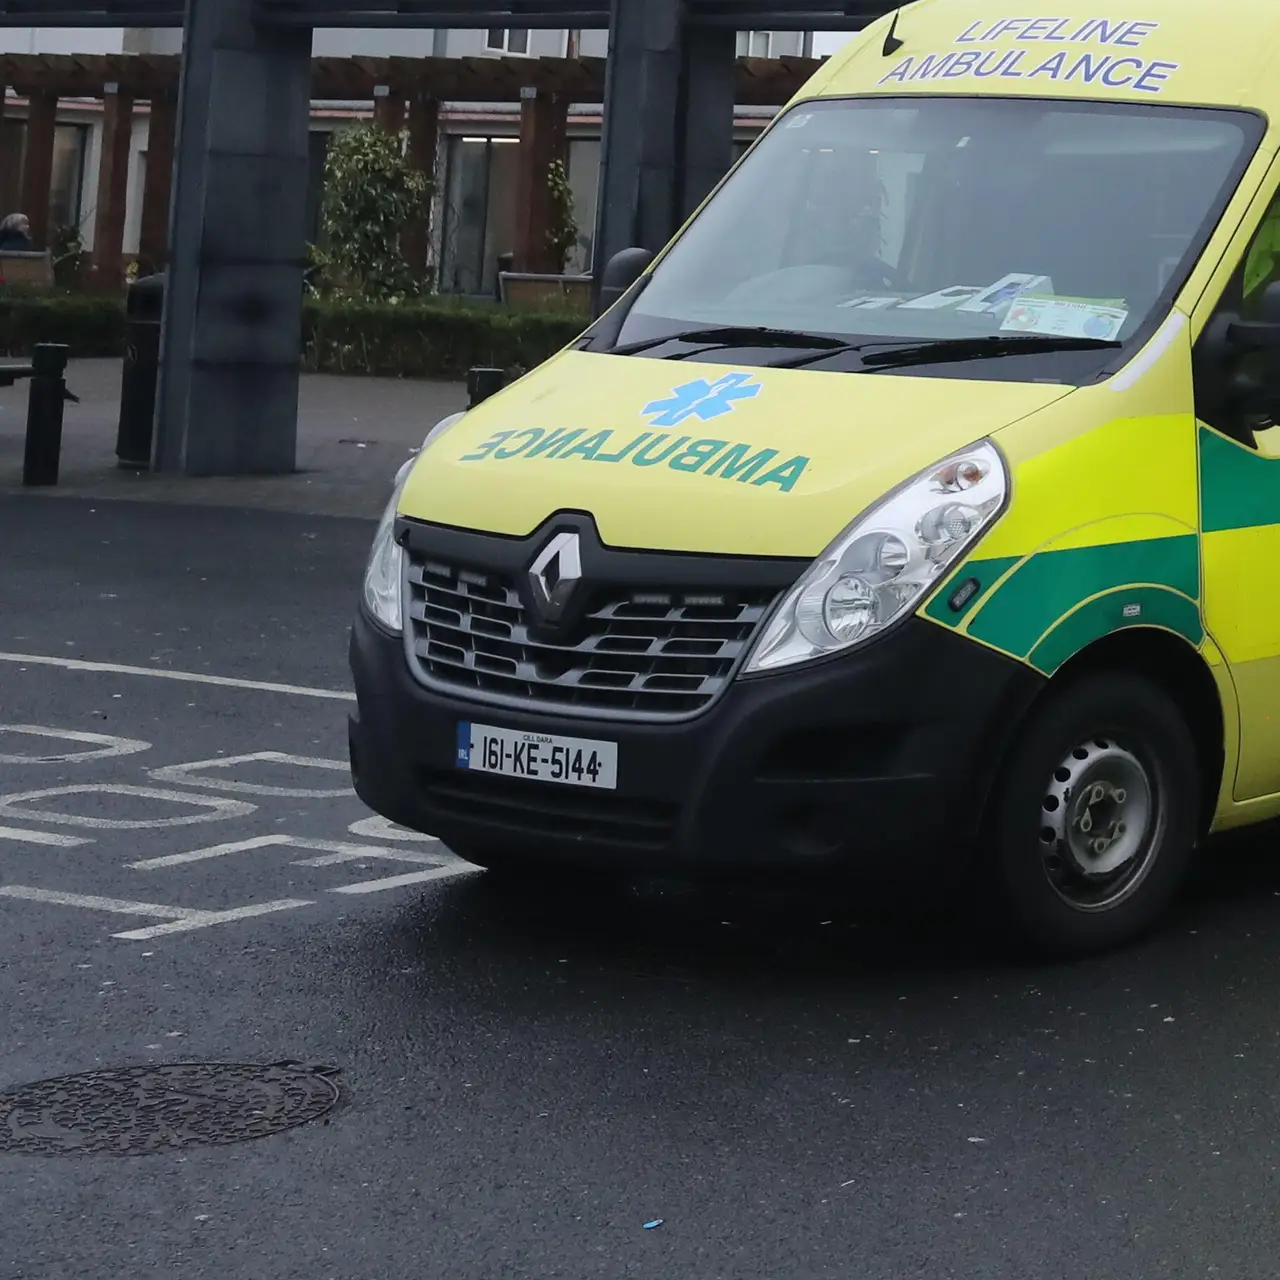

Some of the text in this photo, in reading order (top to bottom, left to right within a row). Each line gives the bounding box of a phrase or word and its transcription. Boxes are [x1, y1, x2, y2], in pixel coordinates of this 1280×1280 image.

[955, 18, 1159, 47] LIFELINE
[877, 49, 1179, 93] AMBULANCE
[482, 734, 601, 784] 161-KE-5144
